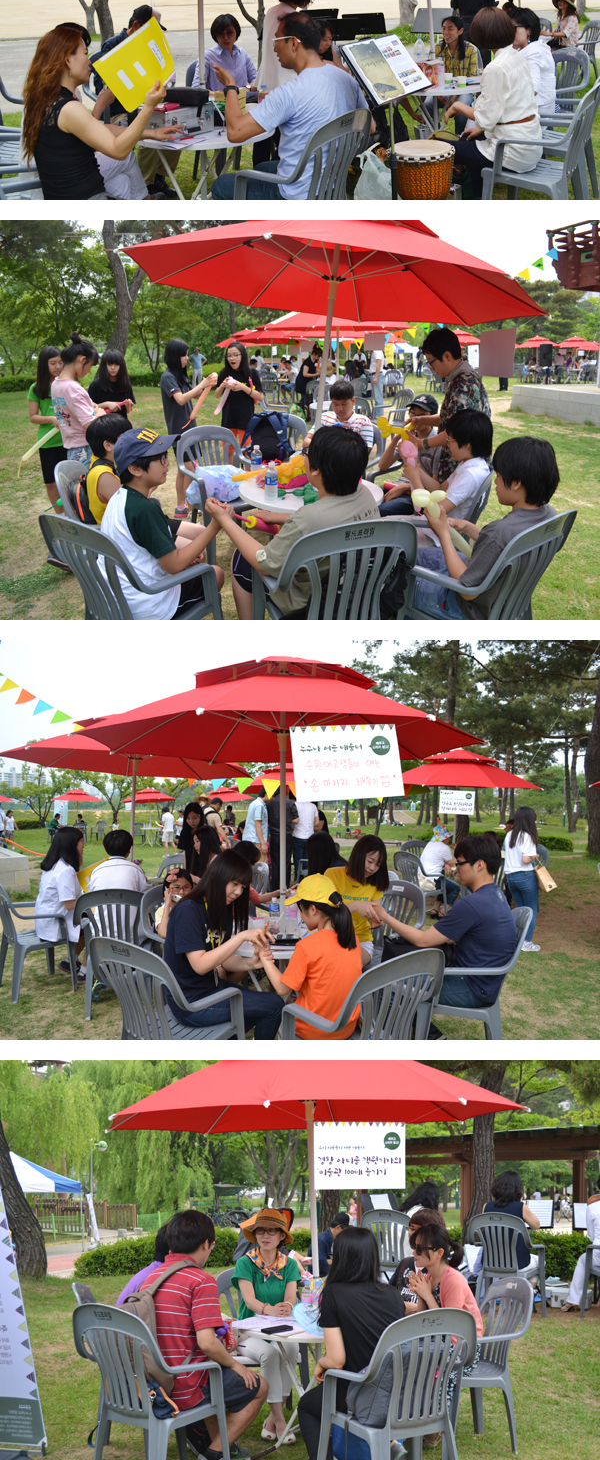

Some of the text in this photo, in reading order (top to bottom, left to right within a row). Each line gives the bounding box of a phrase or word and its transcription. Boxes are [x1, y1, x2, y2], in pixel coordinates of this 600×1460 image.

[300, 745, 321, 753] 누구나
[323, 743, 338, 752] 여는
[339, 742, 363, 751] 배움터
[305, 757, 360, 771] 수원여고생들이
[322, 779, 348, 787] 마사지
[317, 1156, 334, 1166] 경향
[344, 1168, 363, 1176] 100배
